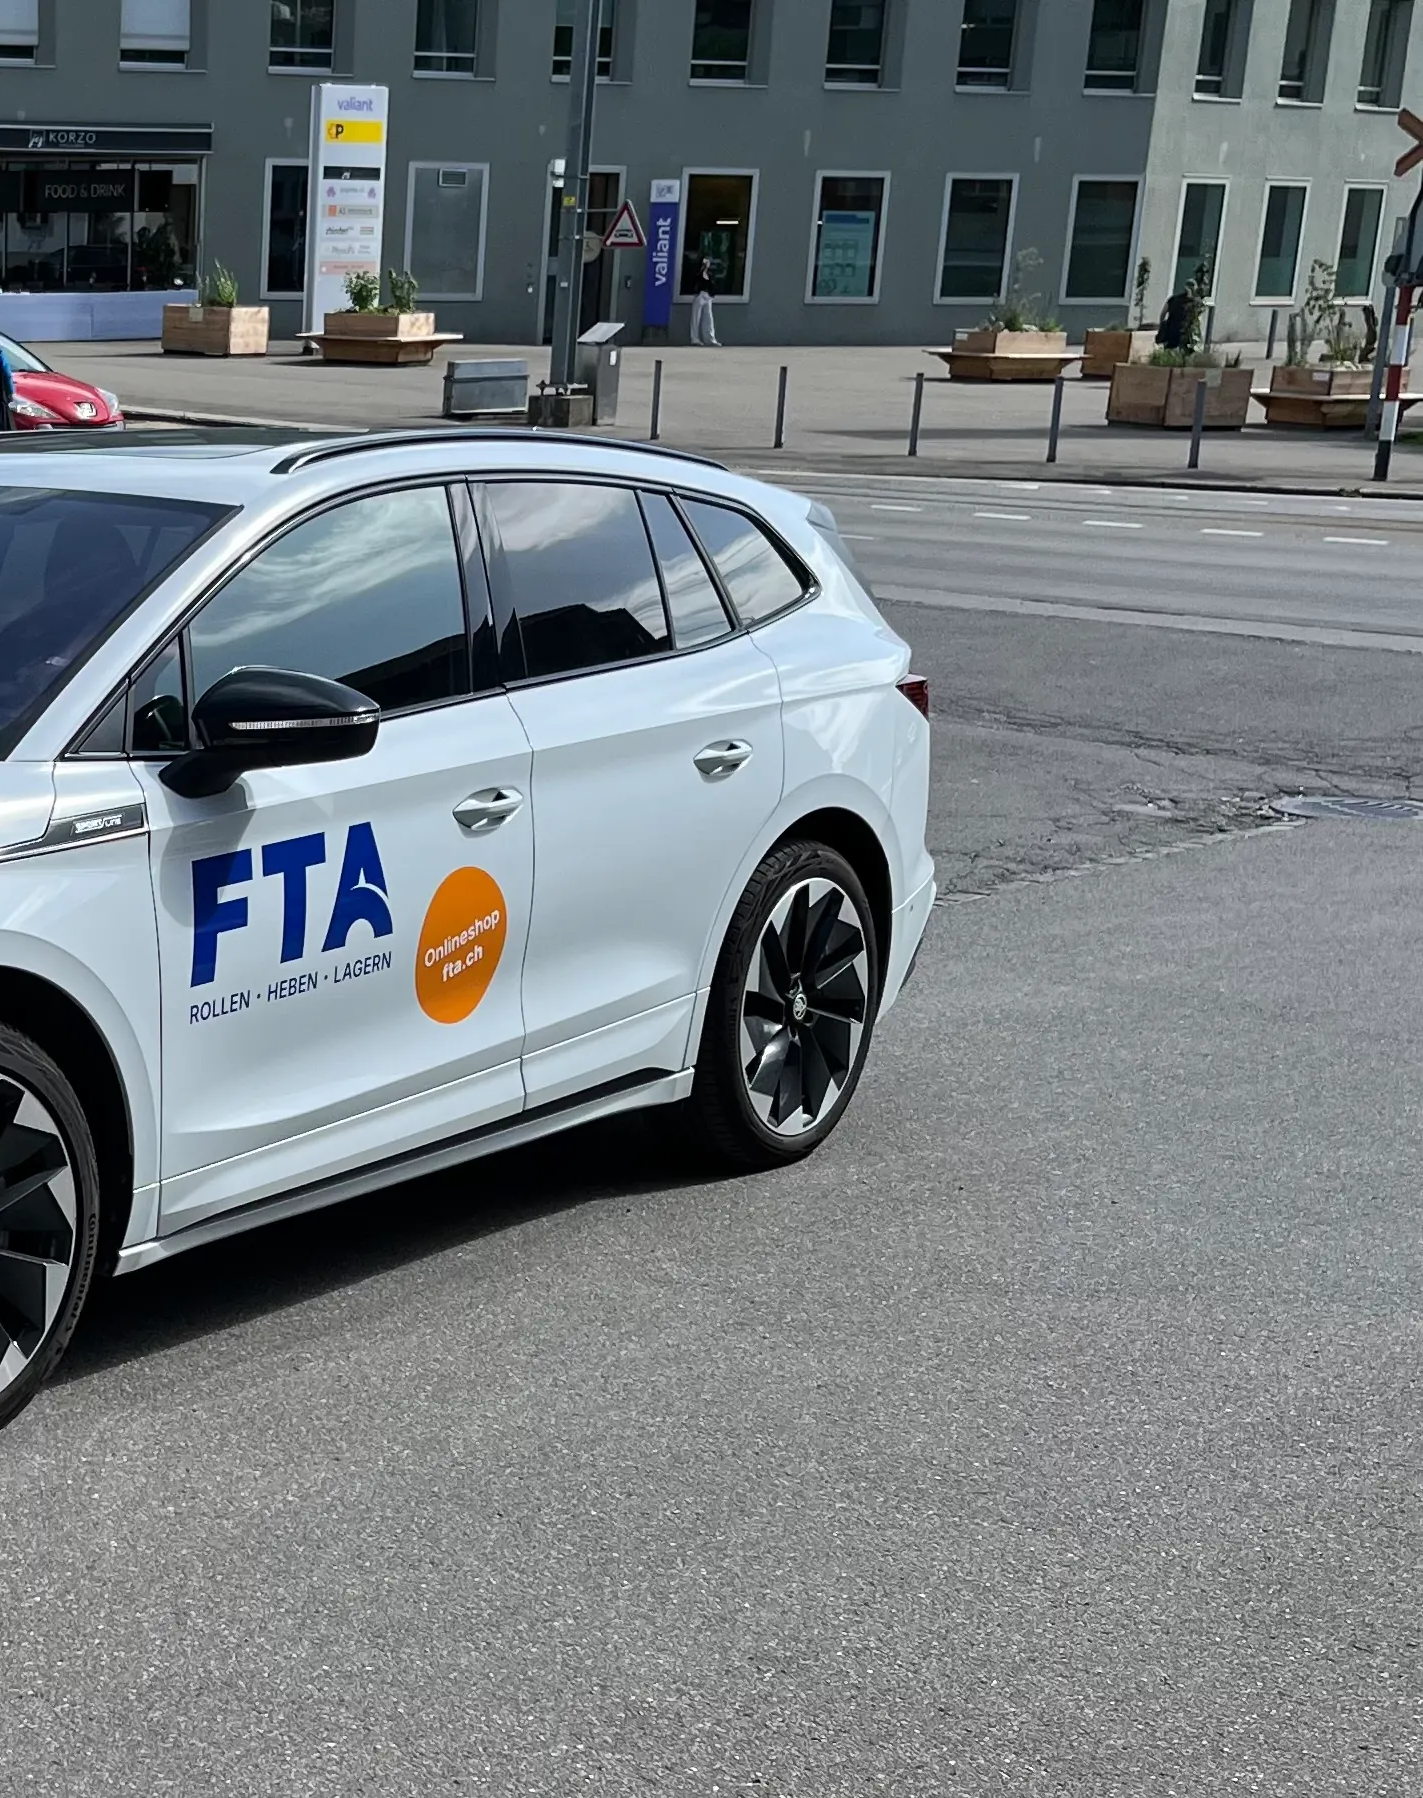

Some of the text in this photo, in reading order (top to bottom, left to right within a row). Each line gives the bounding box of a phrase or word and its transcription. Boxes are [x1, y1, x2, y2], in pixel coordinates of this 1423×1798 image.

[337, 97, 373, 112] valiant
[48, 131, 97, 145] KORZO
[44, 184, 77, 199] FOOD
[90, 183, 126, 199] DRINK
[652, 217, 672, 287] valiant
[189, 821, 394, 989] FTA
[424, 908, 501, 968] Onlineshop
[189, 951, 392, 1025] ROLLEN HEBEN LAGERN
[441, 944, 484, 983] fta.ch
